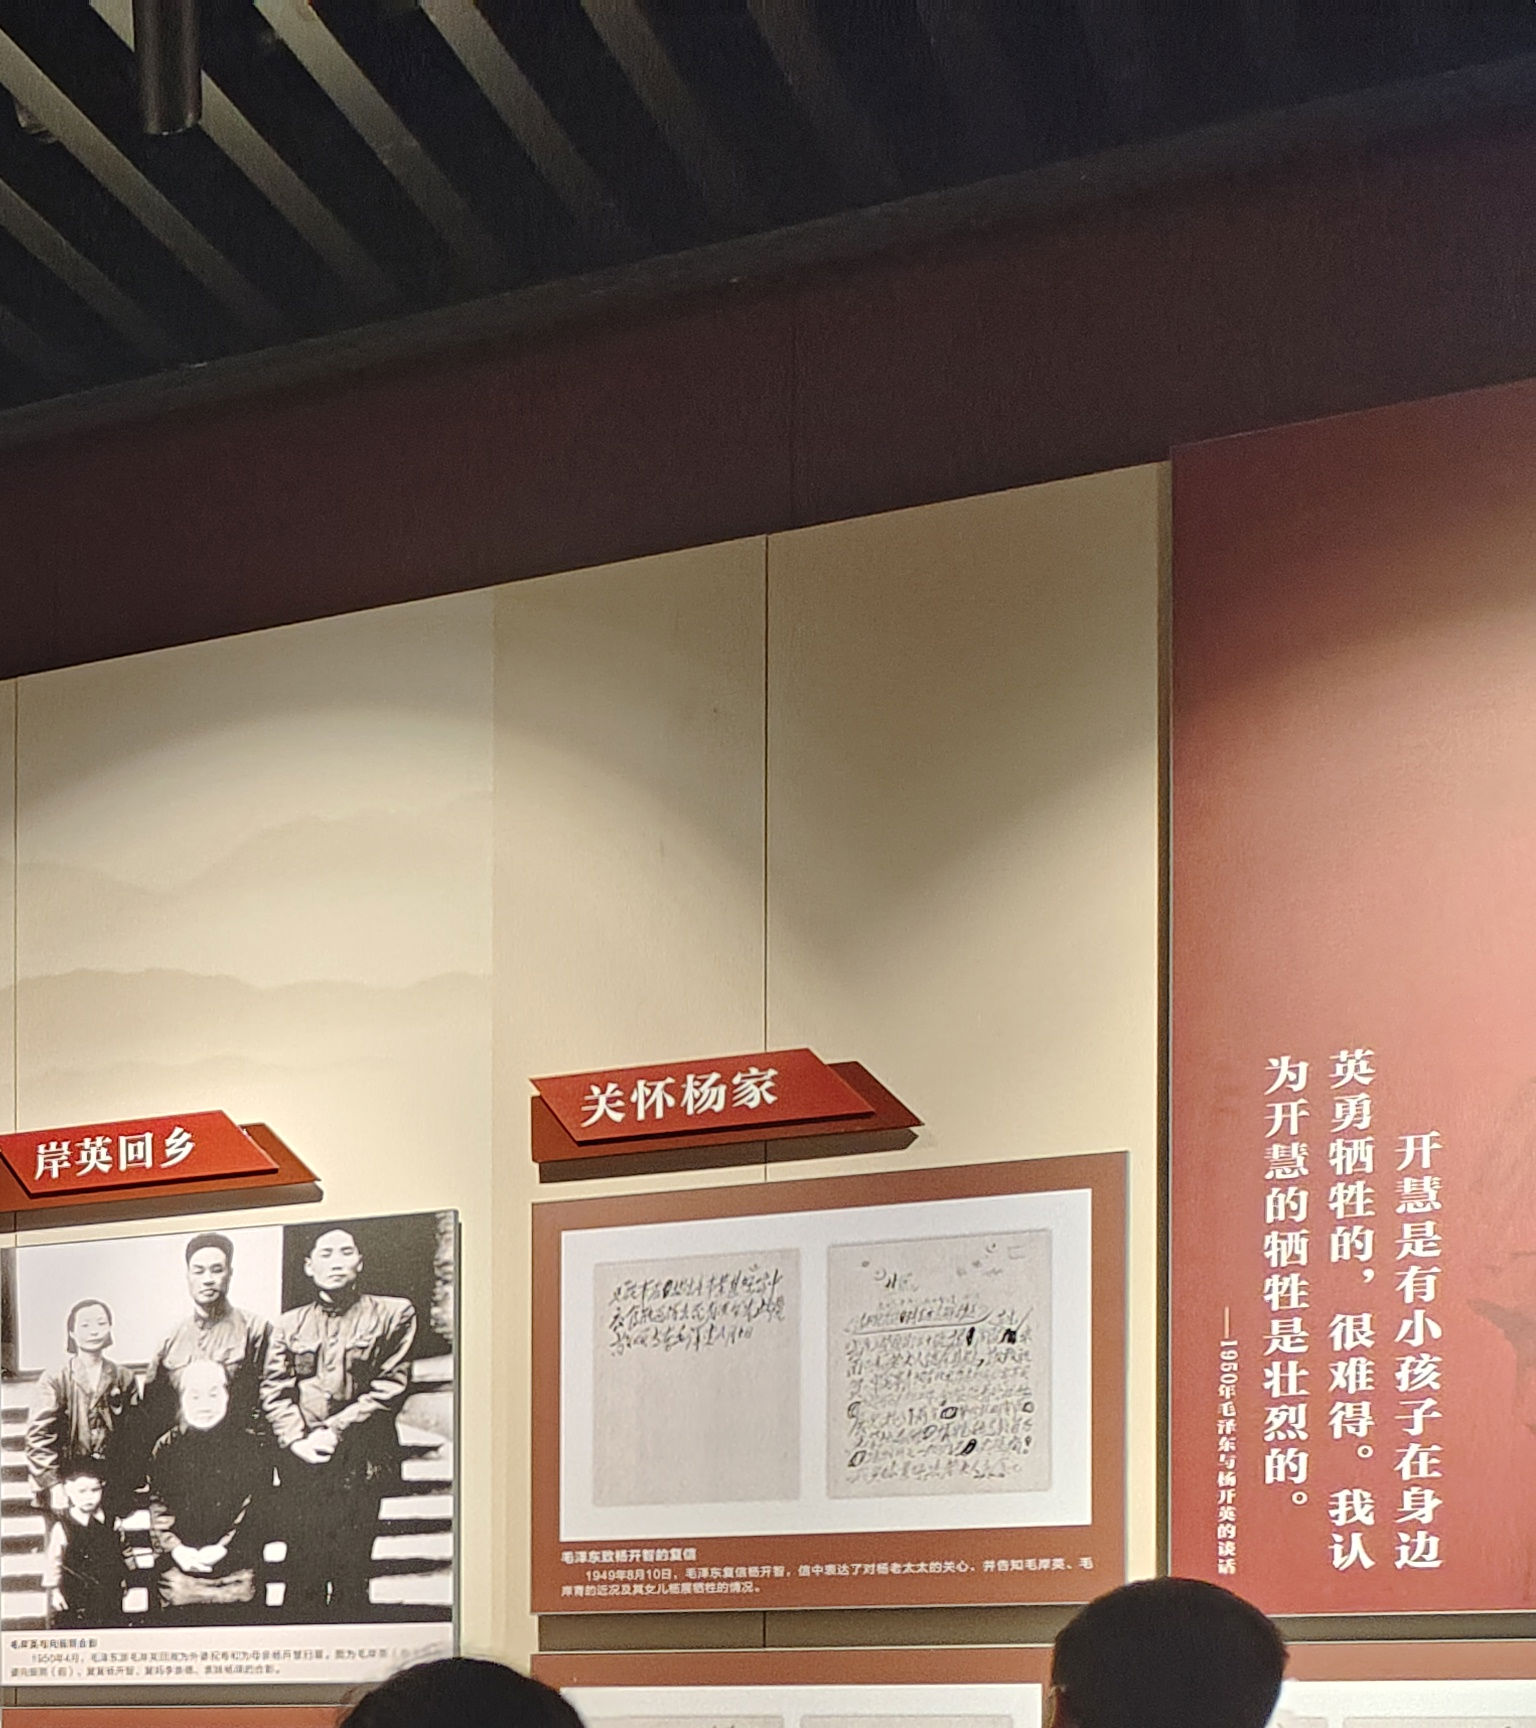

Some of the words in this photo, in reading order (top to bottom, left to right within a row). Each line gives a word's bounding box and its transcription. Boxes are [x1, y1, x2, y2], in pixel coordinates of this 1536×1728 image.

[33, 1125, 196, 1181] 岸英回乡
[579, 1066, 780, 1127] 关怀杨家
[1263, 1055, 1310, 1506] 为开慧的牺牲是壮烈的。
[1327, 1047, 1376, 1571] 英勇牺牲的，很难得。我认
[1394, 1130, 1443, 1570] 开慧是有小孩子在身边
